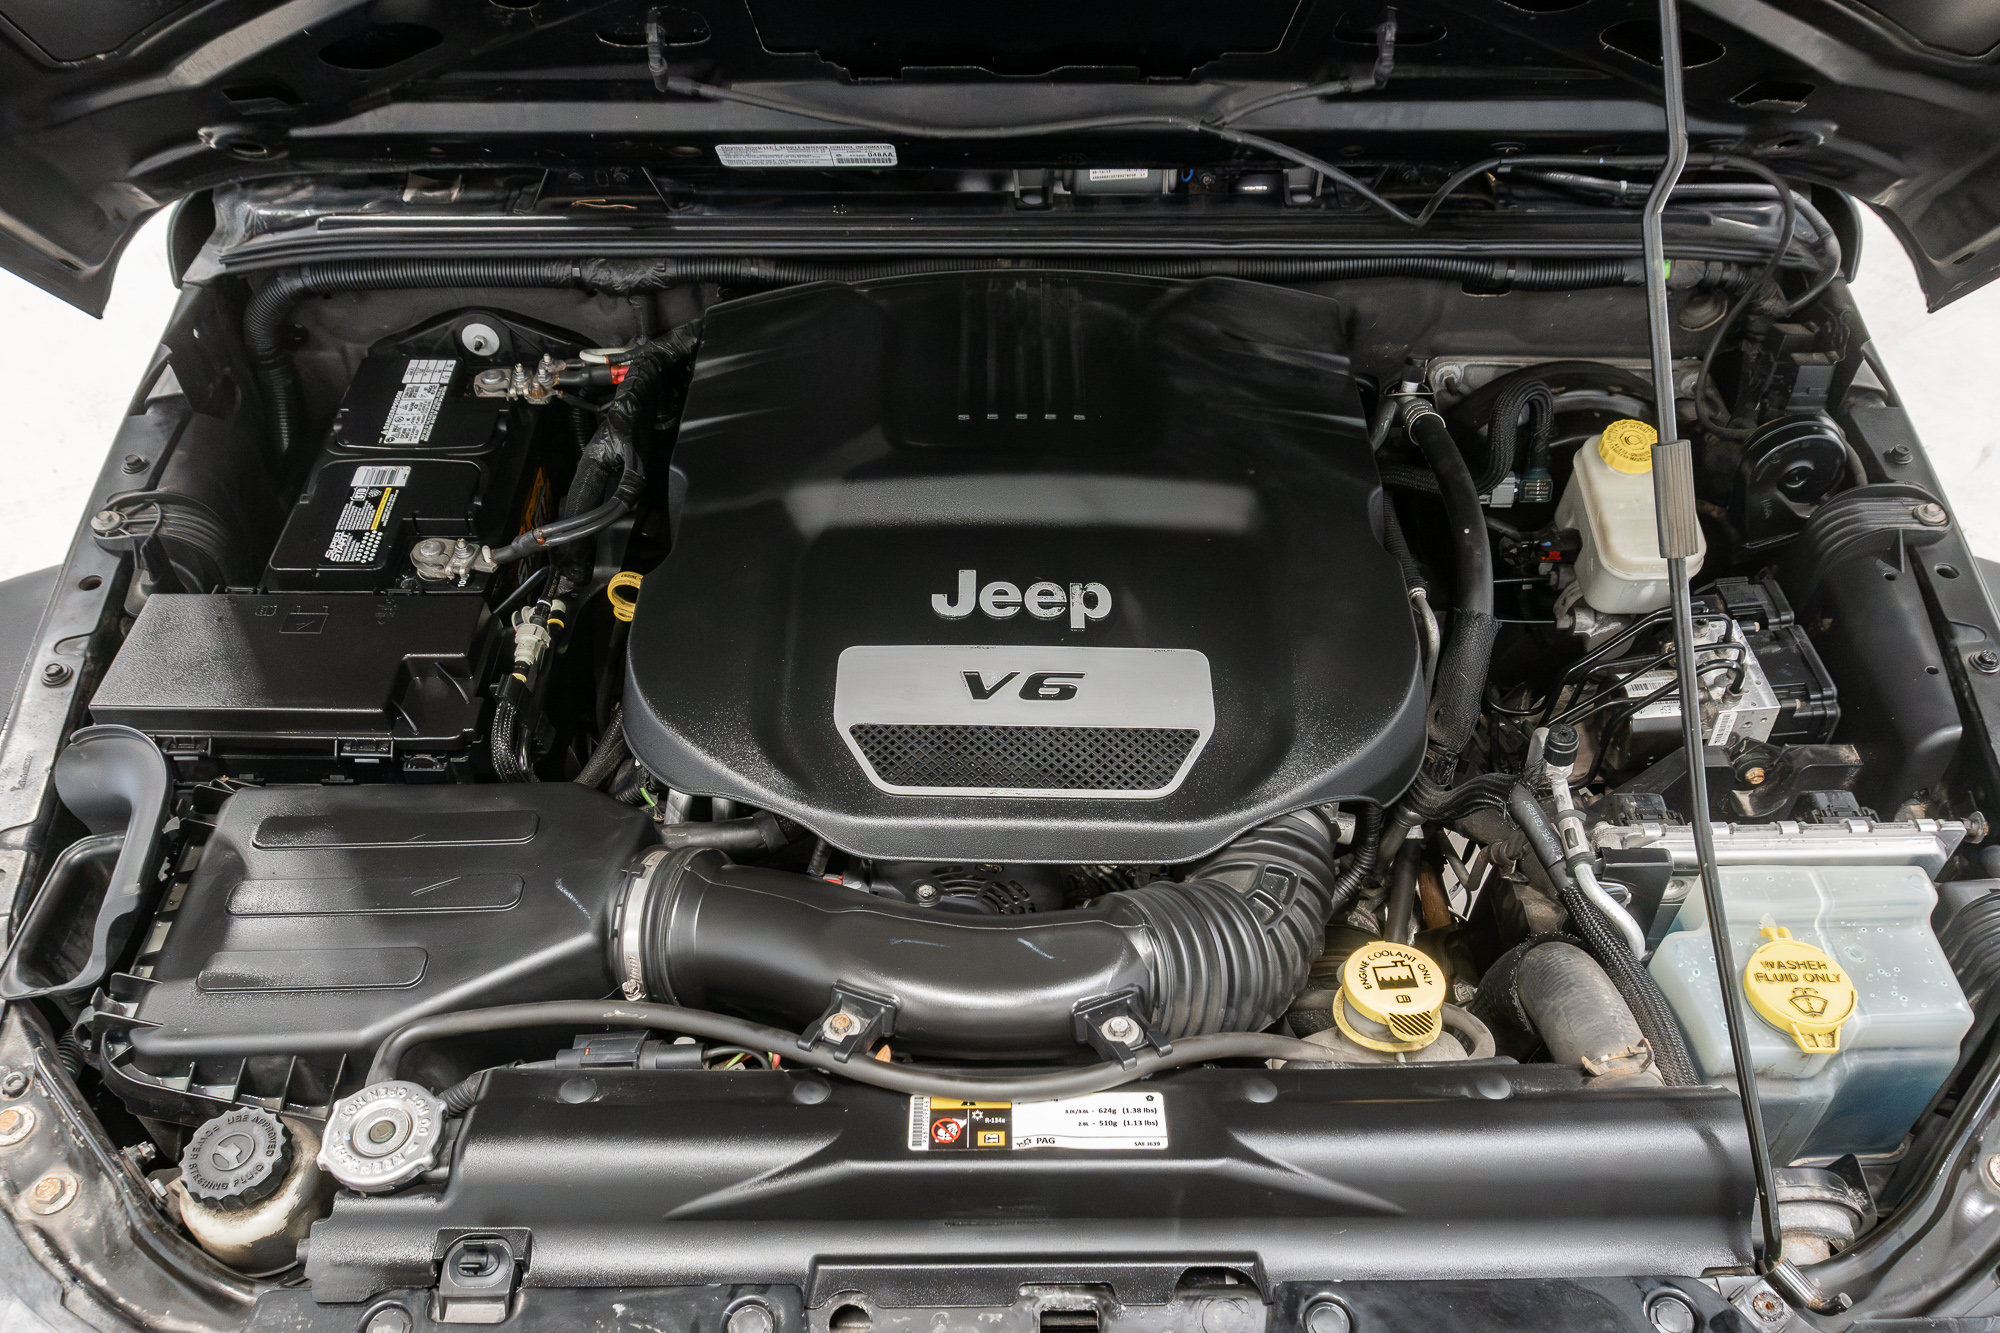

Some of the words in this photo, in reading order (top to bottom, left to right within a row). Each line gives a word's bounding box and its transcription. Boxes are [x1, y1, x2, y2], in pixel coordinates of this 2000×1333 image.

[324, 531, 342, 559] SUPER
[329, 532, 349, 562] START
[931, 569, 1113, 632] Jeep
[962, 671, 1086, 701] V6
[1358, 960, 1373, 990] ENGINE
[1367, 950, 1417, 963] COOLANT
[1417, 963, 1433, 986] ONLY
[1753, 972, 1799, 984] FLUID
[1802, 973, 1841, 983] ONLY
[1760, 960, 1828, 970] WASHER
[1098, 1107, 1117, 1115] 624g
[1122, 1107, 1142, 1115] (1.38
[1143, 1107, 1158, 1115] lbs)
[1099, 1119, 1118, 1127] 510g
[1123, 1119, 1143, 1127] (1.13
[1144, 1119, 1159, 1127] lbs)
[227, 1114, 250, 1125] USE
[251, 1115, 277, 1157] APPROVED
[1036, 1137, 1056, 1145] PAG
[188, 1162, 230, 1191] STEERING
[233, 1163, 265, 1188] FLUID
